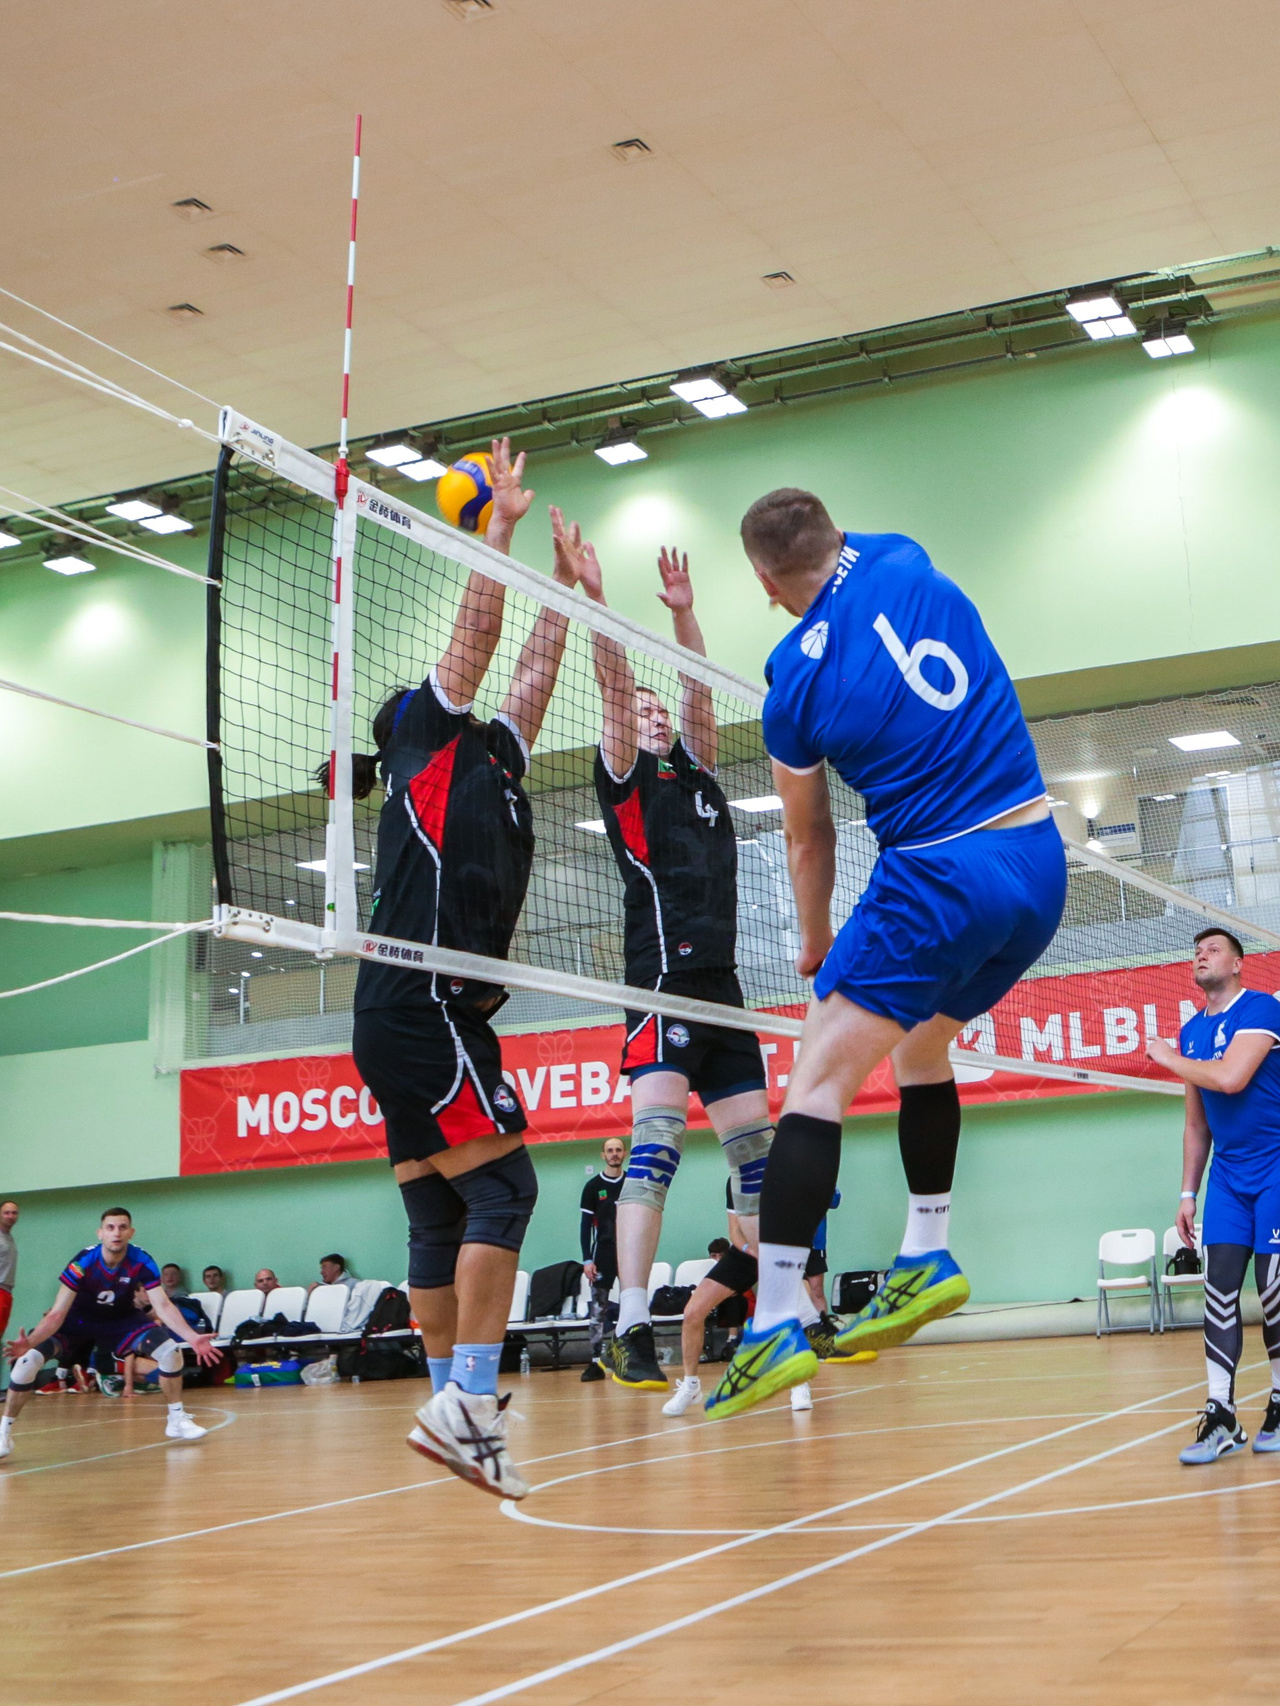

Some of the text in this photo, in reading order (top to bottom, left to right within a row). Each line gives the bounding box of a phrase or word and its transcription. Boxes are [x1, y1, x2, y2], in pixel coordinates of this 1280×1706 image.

[873, 612, 969, 711] 6
[695, 791, 719, 827] 4
[237, 1085, 386, 1138] MOSCO
